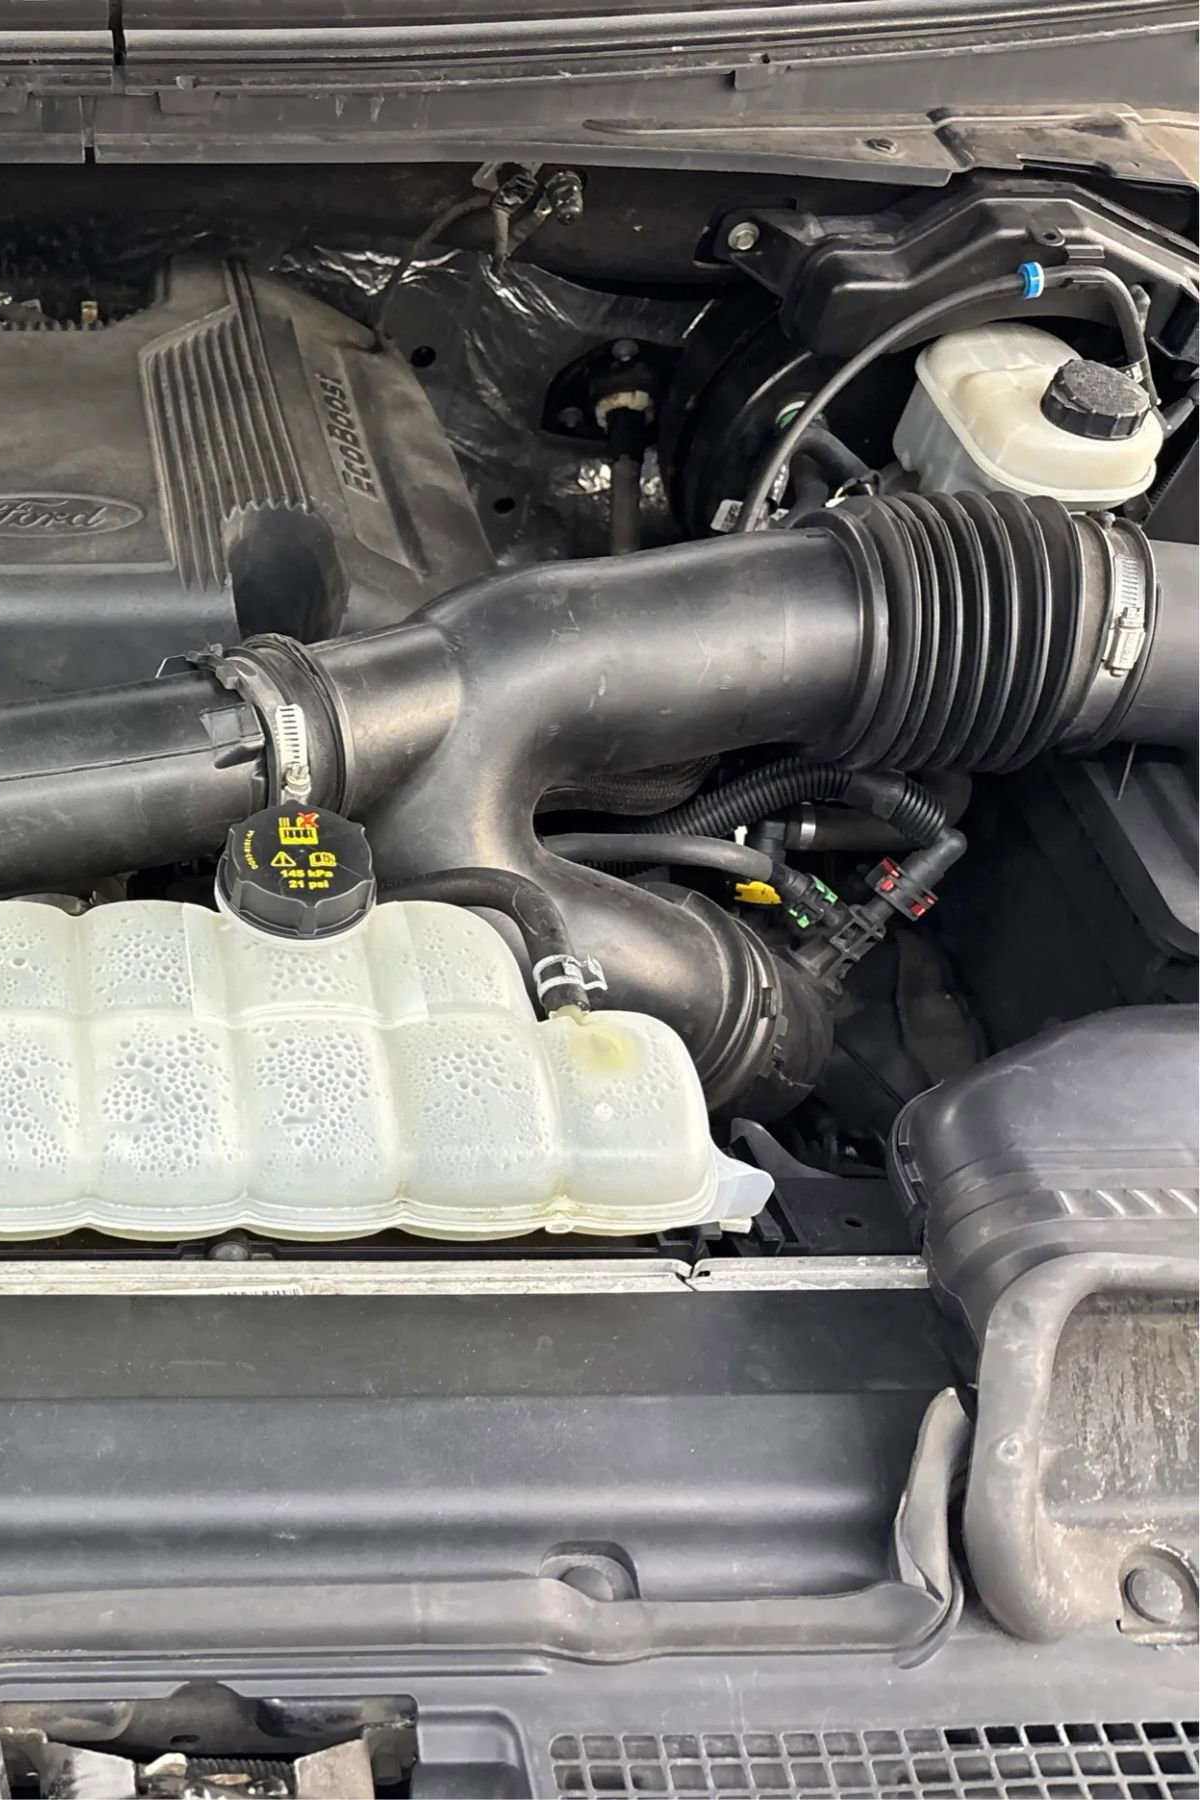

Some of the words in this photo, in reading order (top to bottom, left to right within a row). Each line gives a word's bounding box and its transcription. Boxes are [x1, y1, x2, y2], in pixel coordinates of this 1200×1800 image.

[314, 371, 379, 502] EcoBoost
[280, 869, 305, 878] 145
[307, 869, 334, 878] kPa
[288, 880, 305, 889] 21
[308, 880, 330, 890] psi
